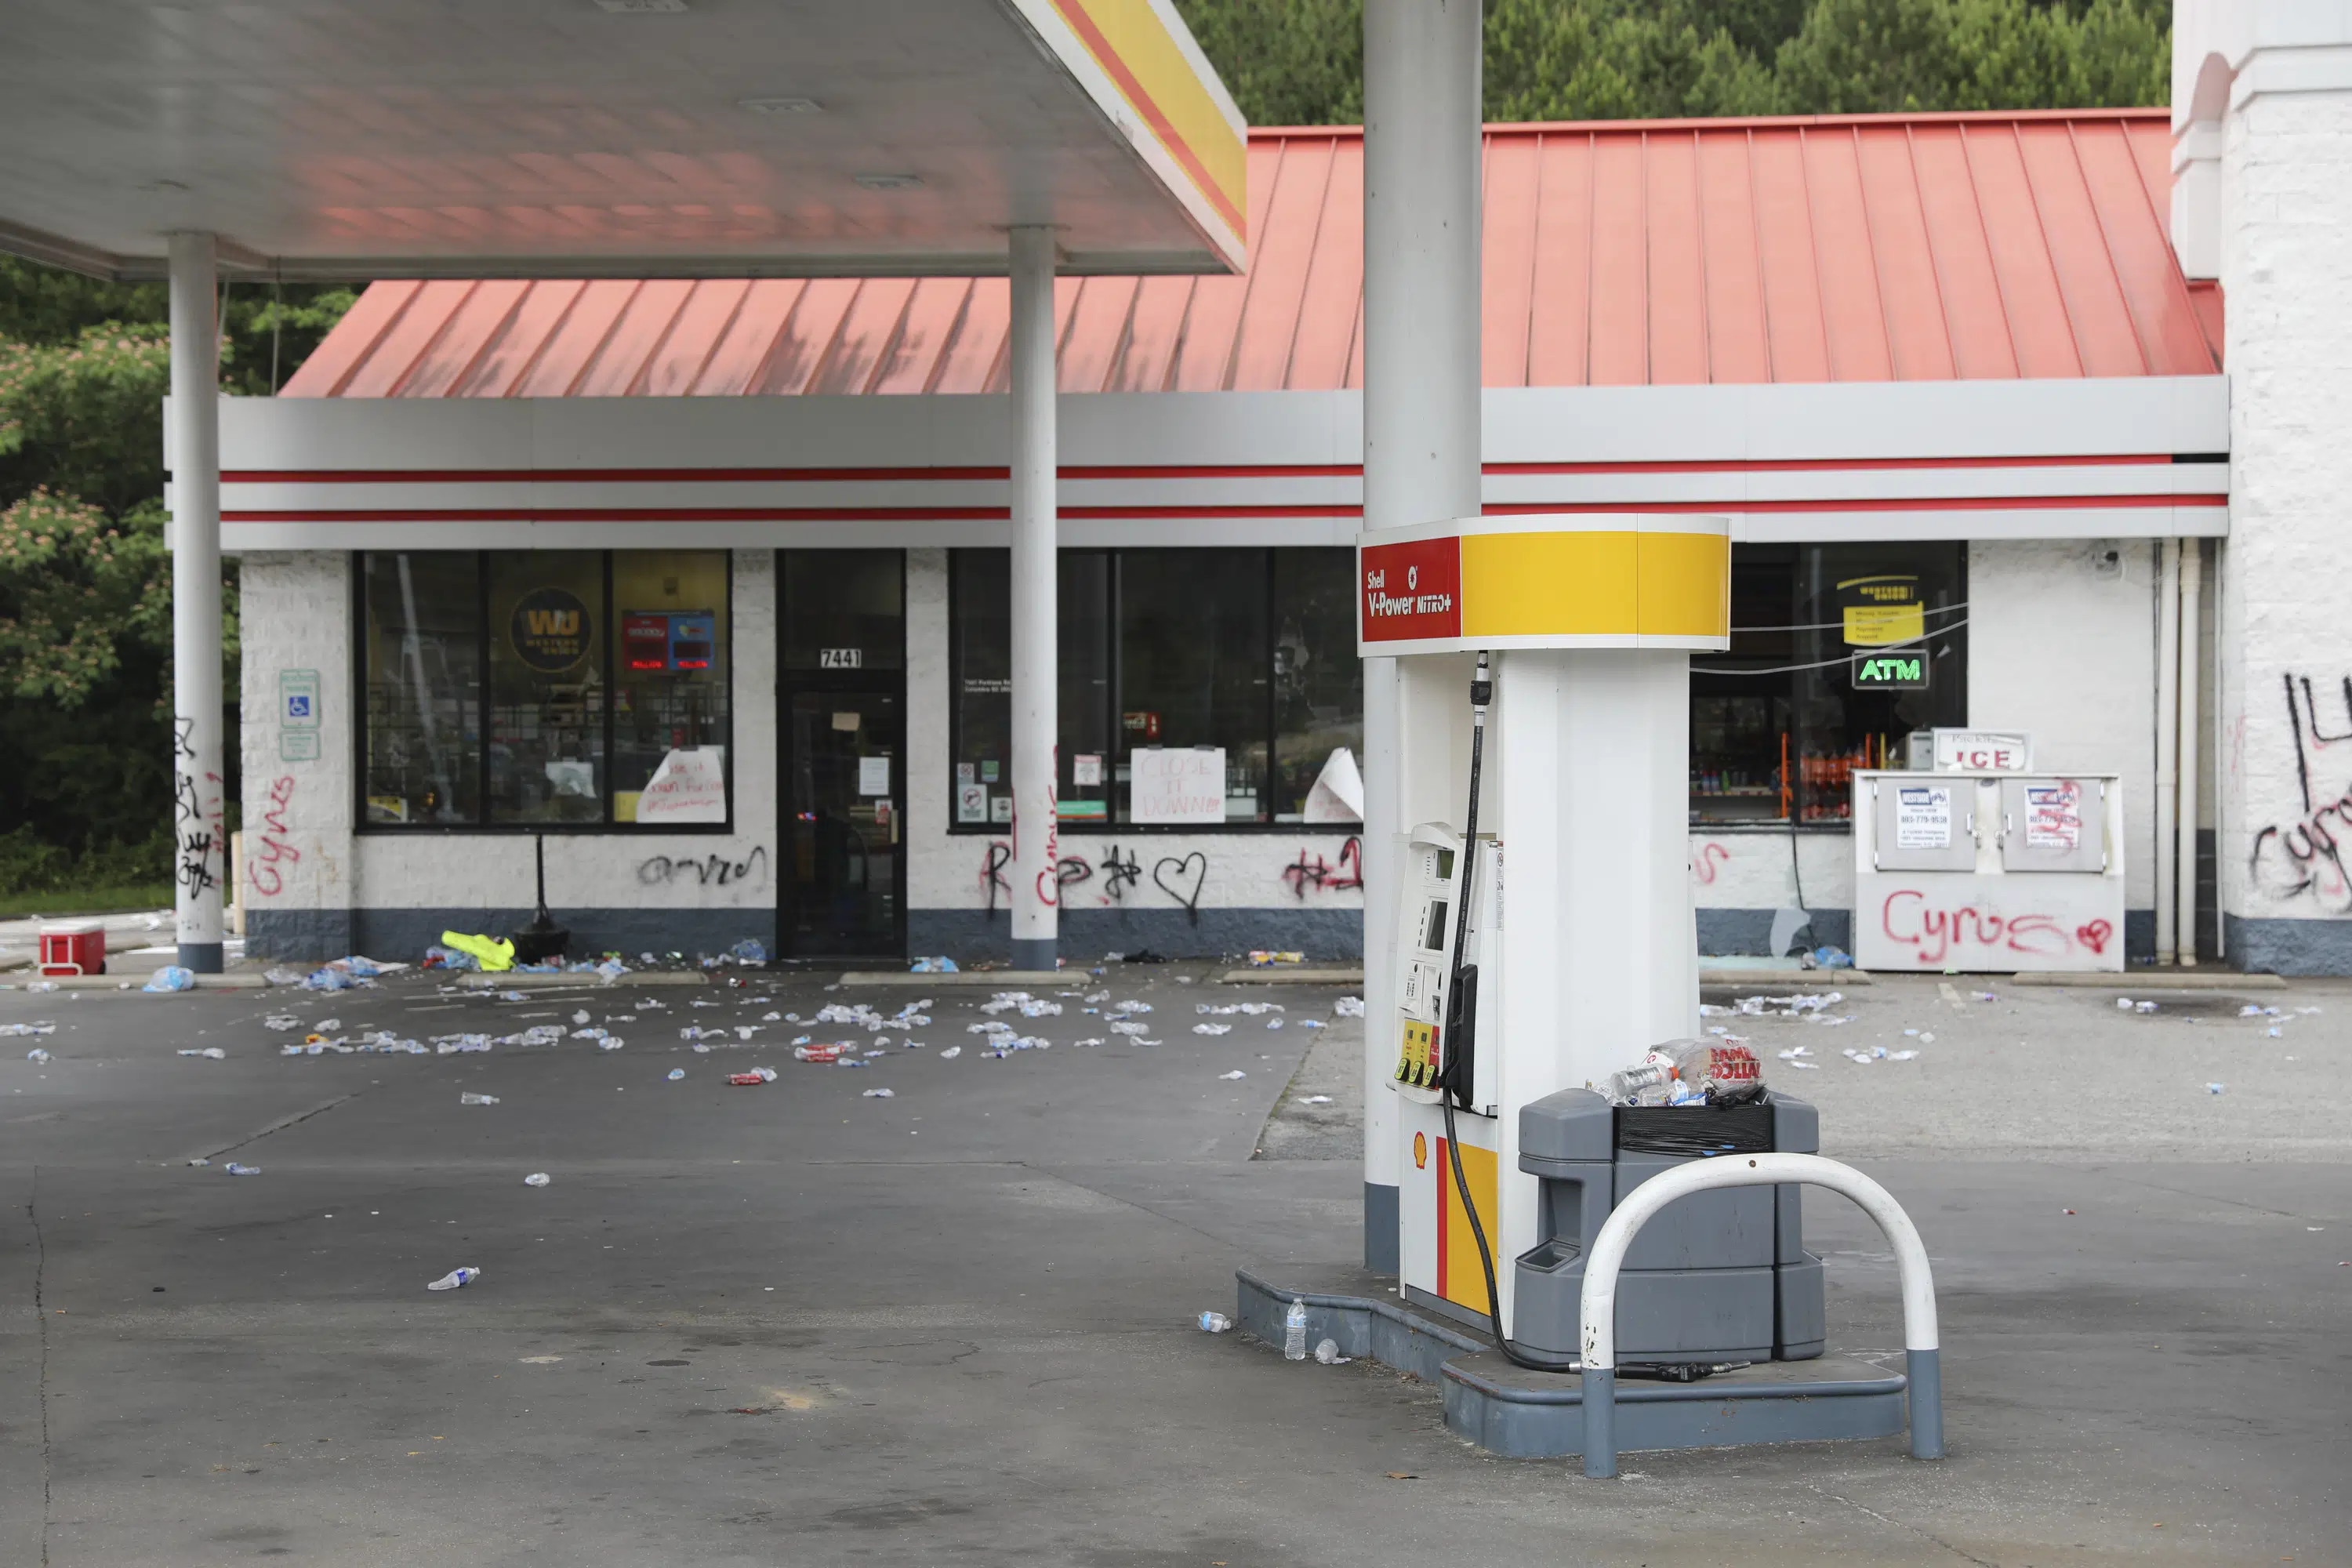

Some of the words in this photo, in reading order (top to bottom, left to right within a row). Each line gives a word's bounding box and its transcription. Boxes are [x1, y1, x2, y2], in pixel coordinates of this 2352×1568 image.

[1367, 569, 1385, 590] Shell
[1368, 592, 1413, 617] V-Power
[822, 650, 860, 667] 7441
[1859, 659, 1920, 681] ATM
[1141, 753, 1212, 778] CLOSE
[1956, 750, 2010, 769] ICE
[1901, 791, 1931, 804] WESTSIDE
[1883, 890, 2074, 963] Cyrus
[1709, 1046, 1759, 1062] FAMIL
[1708, 1062, 1762, 1080] DOLLA
